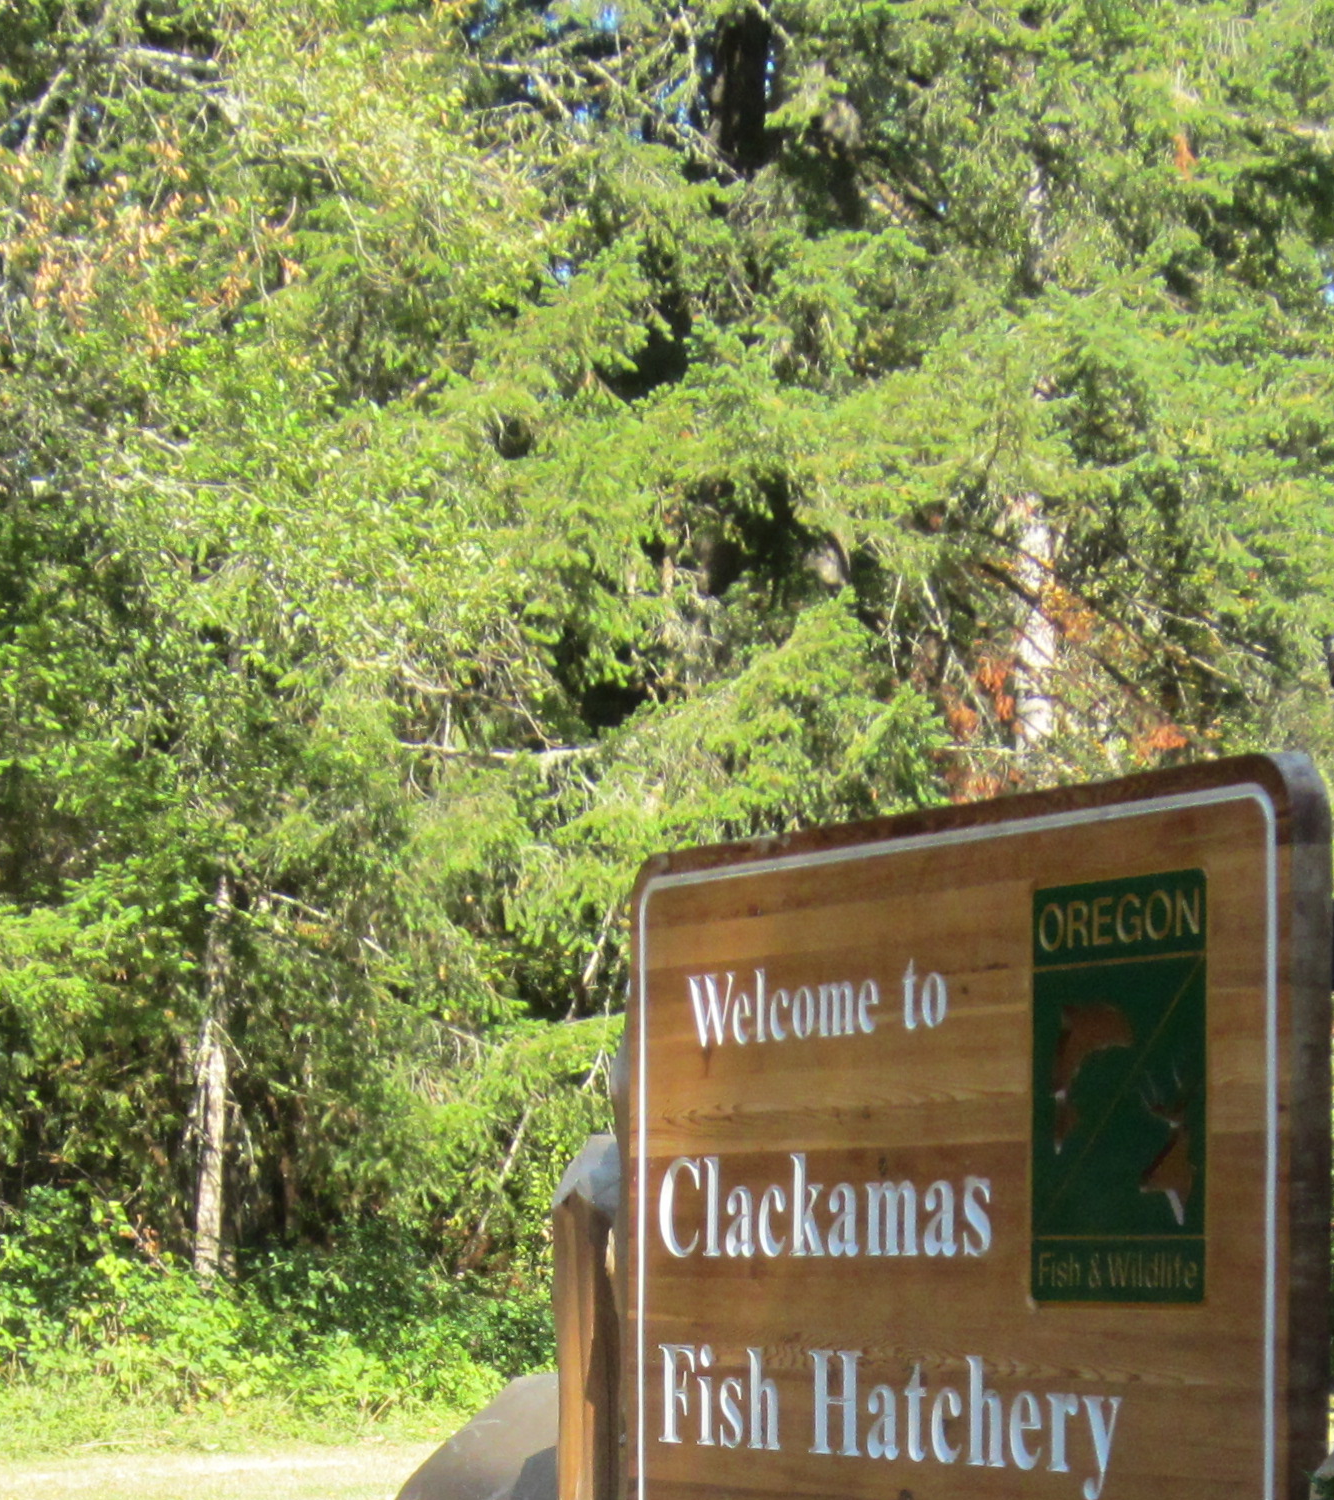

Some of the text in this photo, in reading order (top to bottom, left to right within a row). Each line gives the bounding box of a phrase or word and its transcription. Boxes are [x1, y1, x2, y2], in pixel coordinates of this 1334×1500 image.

[1038, 887, 1201, 952] OREGON
[686, 957, 948, 1048] Welcome to
[658, 1152, 993, 1258] Clackamas
[1038, 1251, 1199, 1289] Fish & Wildlife
[658, 1343, 781, 1451] Fish
